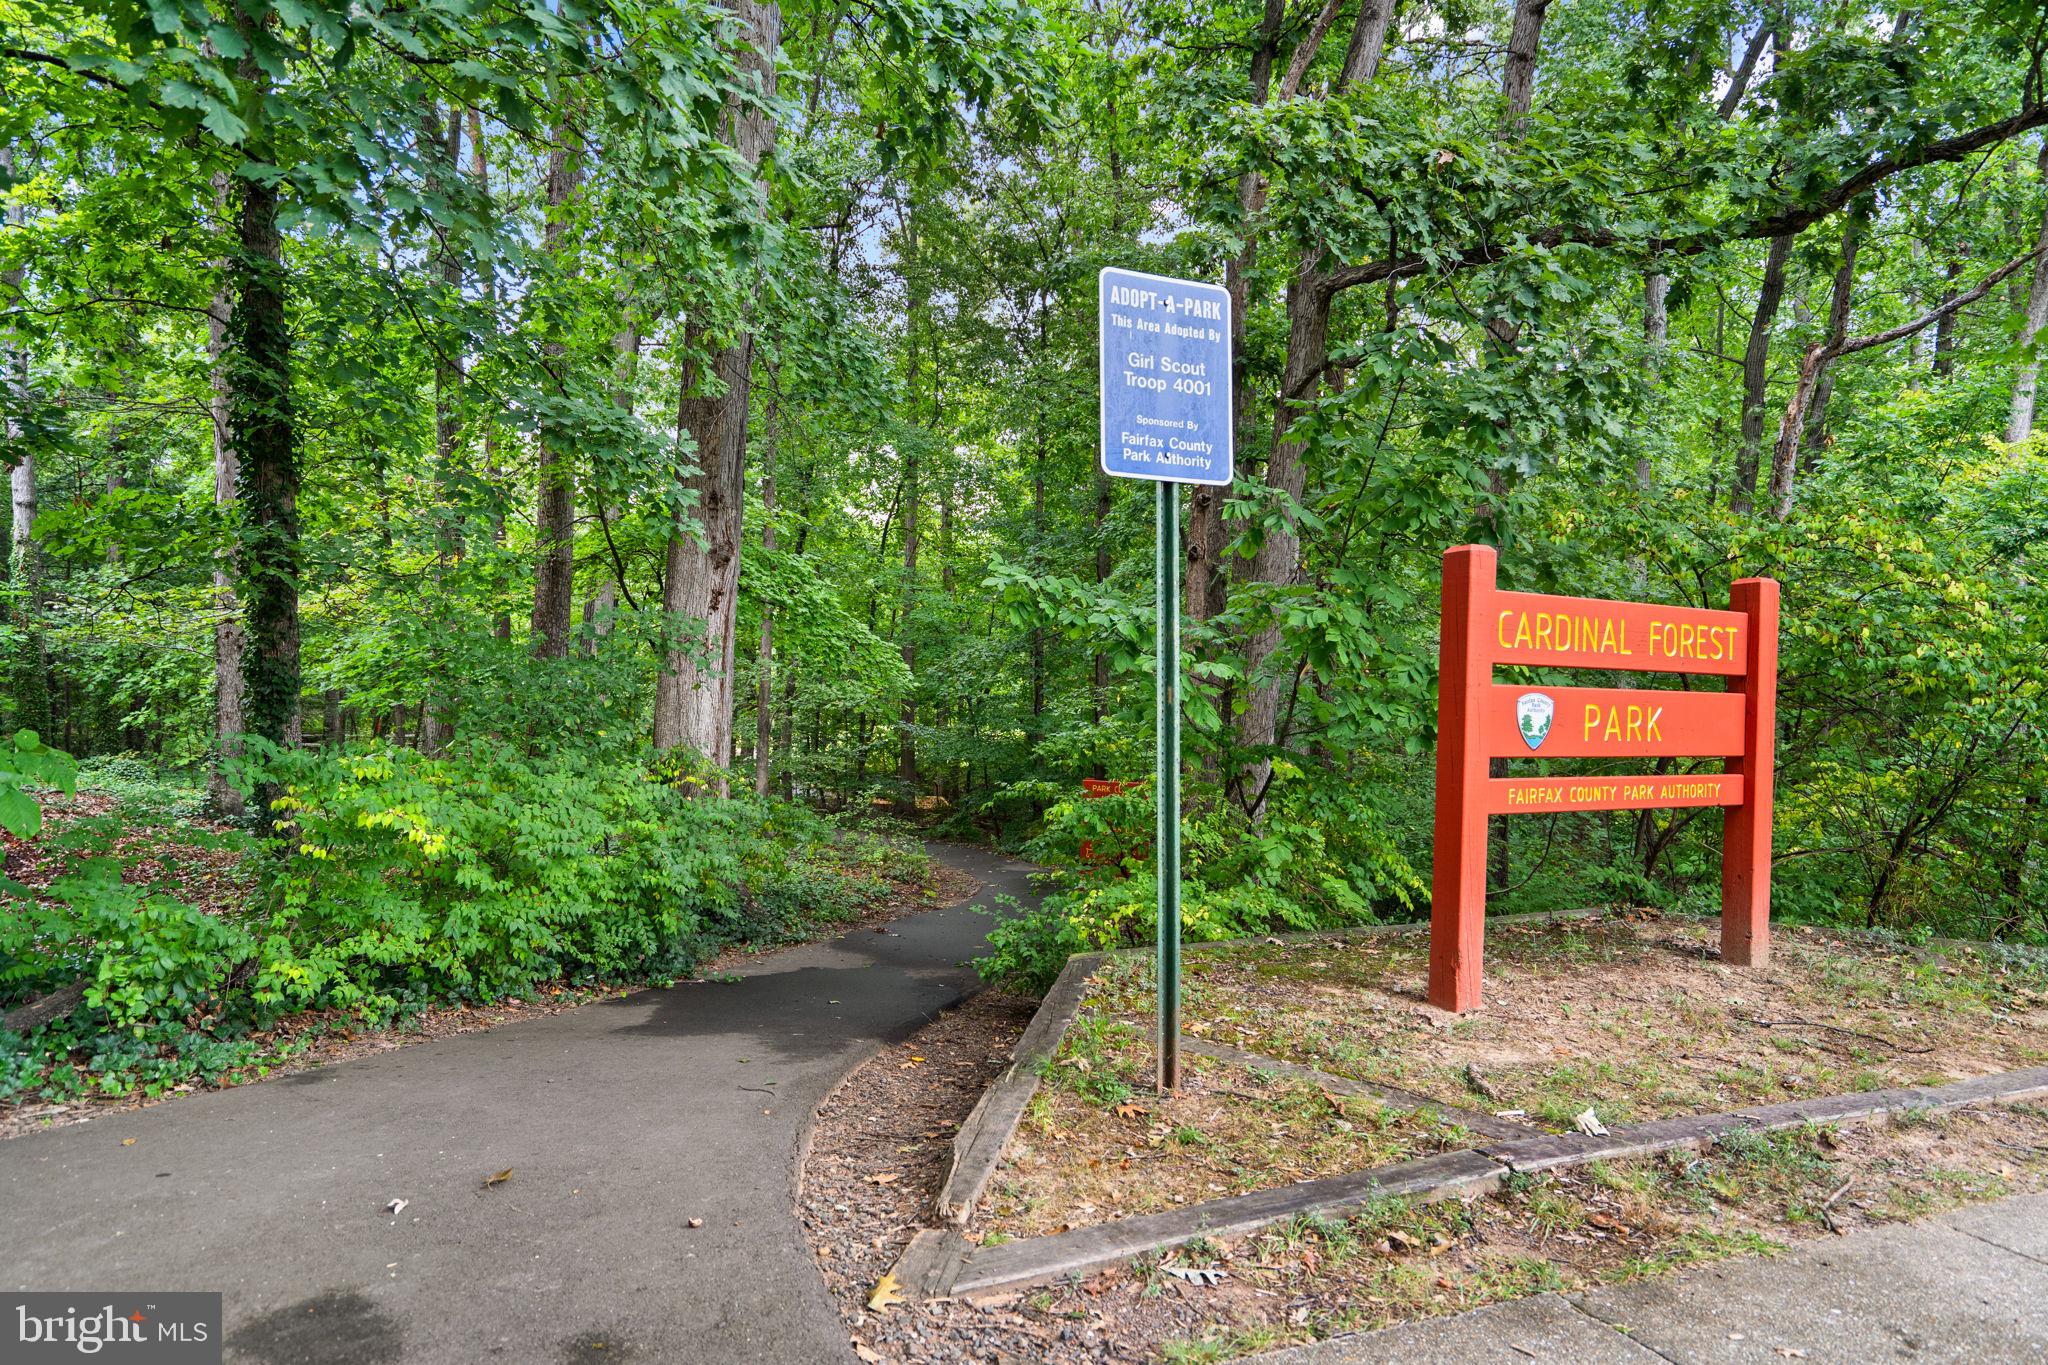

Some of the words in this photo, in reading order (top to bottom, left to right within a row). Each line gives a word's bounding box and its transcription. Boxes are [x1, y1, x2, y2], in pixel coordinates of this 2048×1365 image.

[1110, 285, 1221, 321] ADOPT-A-PARK
[1111, 313, 1133, 329] This
[1137, 318, 1161, 333] Area
[1164, 322, 1205, 340] Adopted
[1208, 328, 1221, 344] By
[1128, 351, 1154, 370] Girl
[1160, 356, 1206, 377] Scout
[1123, 371, 1167, 393] Troop
[1173, 378, 1211, 396] 4001
[1136, 414, 1184, 429] Sponsored
[1186, 420, 1199, 432] By
[1121, 431, 1164, 448] Fairfax
[1169, 436, 1213, 455] County
[1123, 448, 1151, 463] Park
[1156, 450, 1212, 470] Authority
[1498, 609, 1633, 655] CARDINAL
[1649, 621, 1738, 661] FOREST
[1584, 704, 1663, 743] PARK
[1508, 786, 1563, 805] FAIRFAX
[1569, 786, 1617, 803] COUNTY
[1623, 784, 1655, 800] PARK
[1660, 782, 1721, 800] AUTHORITY
